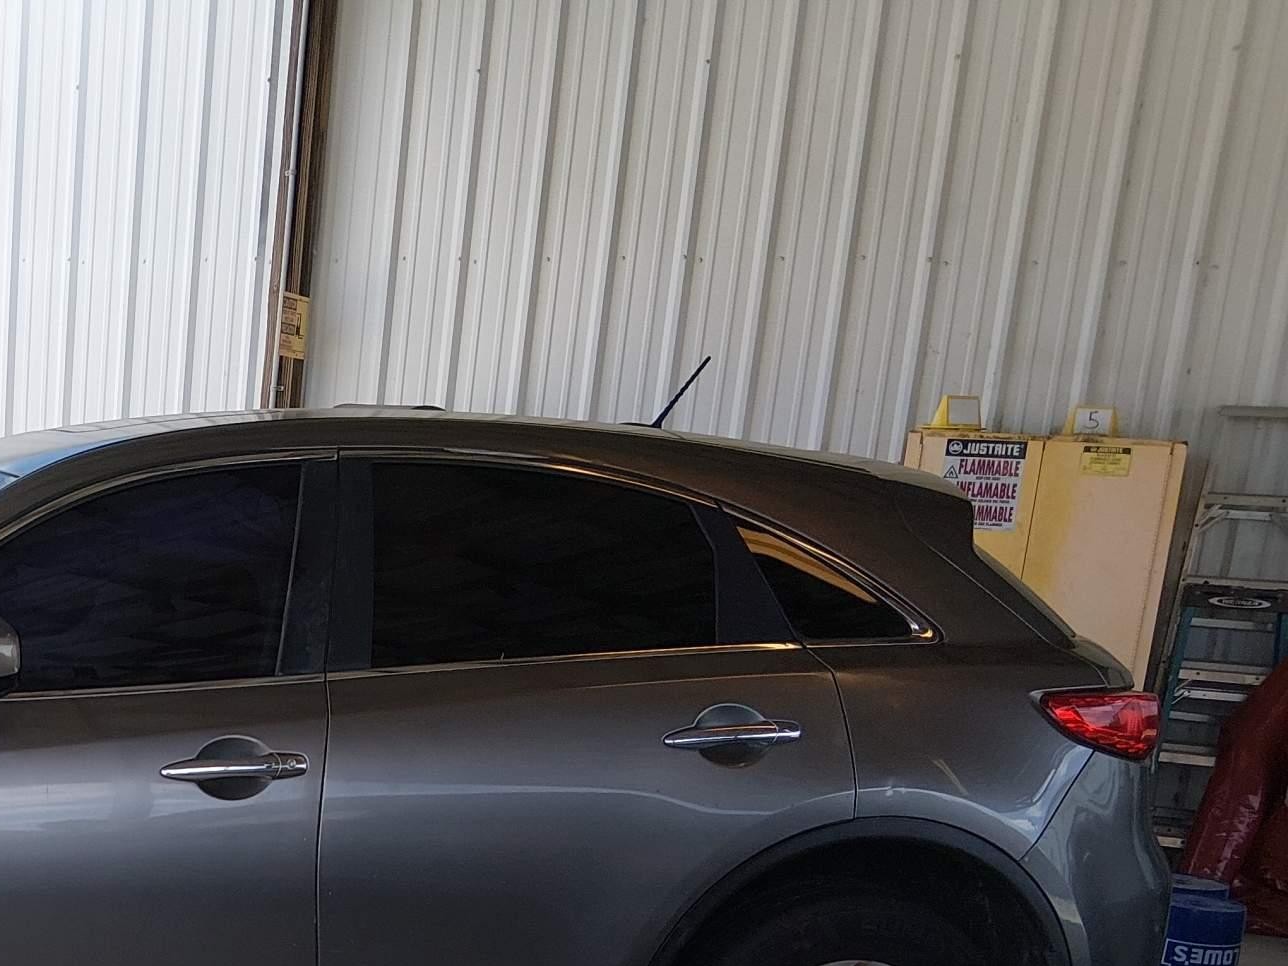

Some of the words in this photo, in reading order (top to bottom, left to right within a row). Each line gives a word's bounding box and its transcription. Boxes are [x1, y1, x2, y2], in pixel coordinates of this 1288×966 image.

[1083, 410, 1100, 430] 5
[963, 442, 1020, 456] JUSTRITE
[957, 458, 1021, 477] FLAMMABLE
